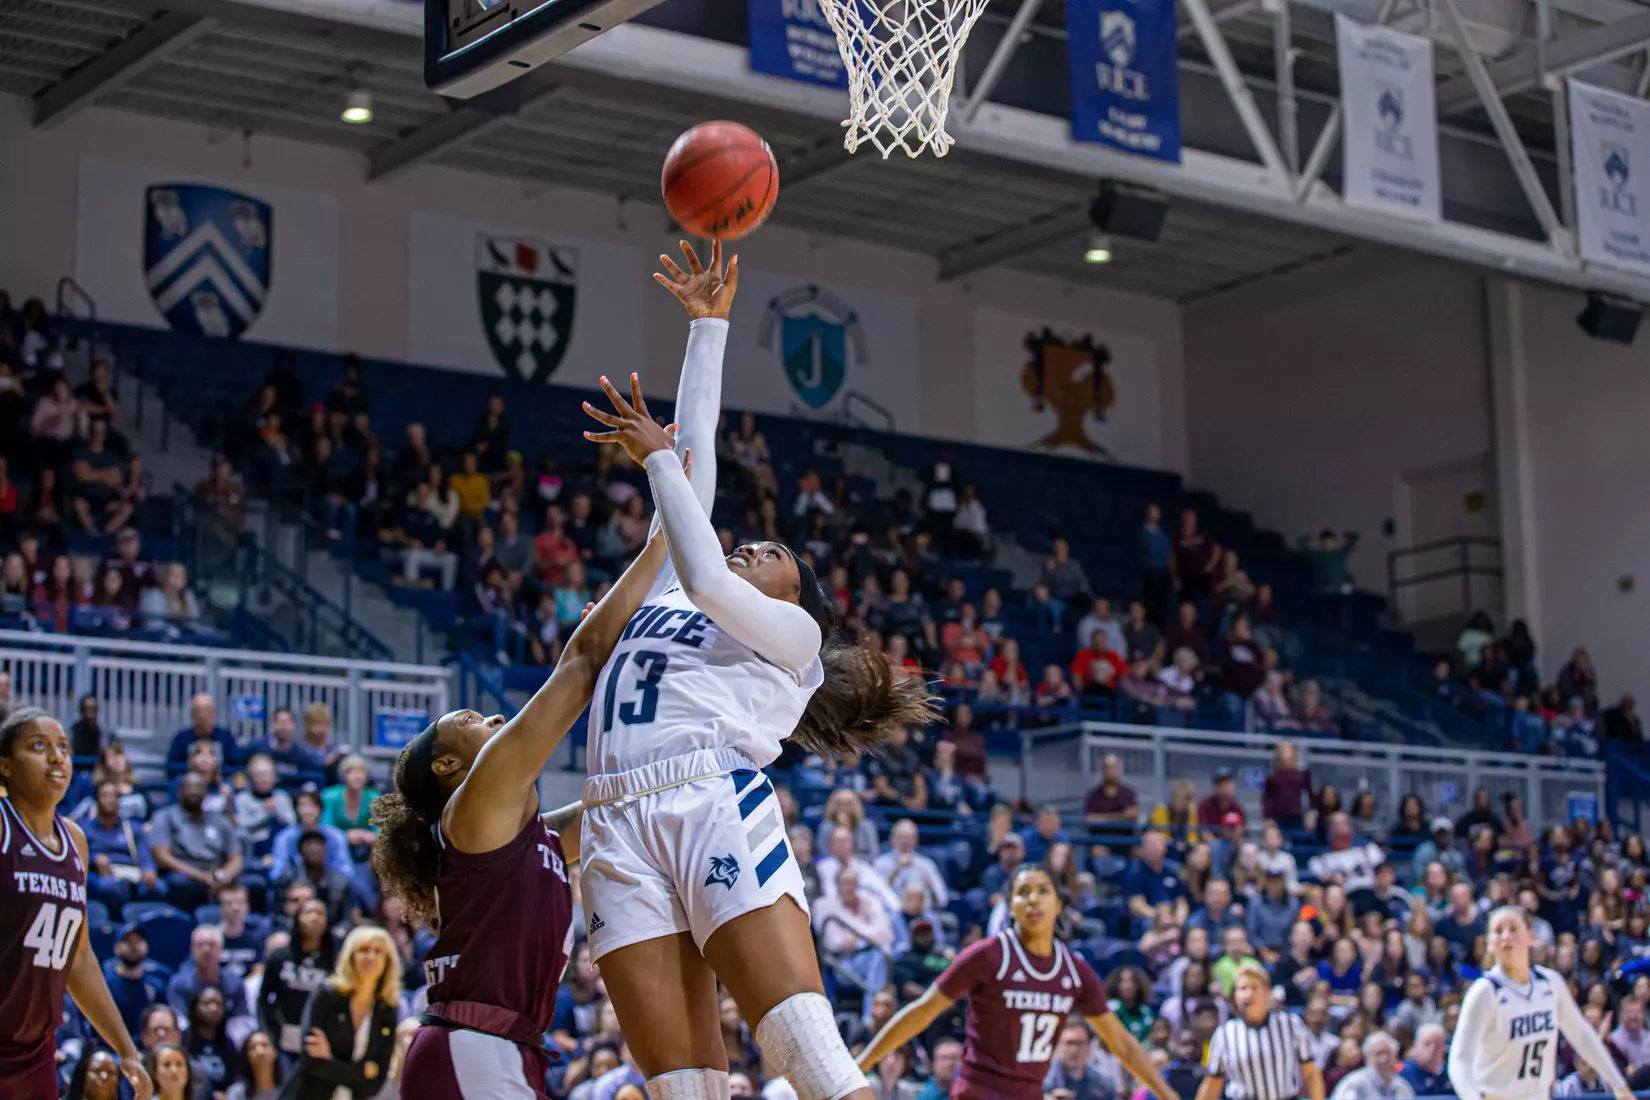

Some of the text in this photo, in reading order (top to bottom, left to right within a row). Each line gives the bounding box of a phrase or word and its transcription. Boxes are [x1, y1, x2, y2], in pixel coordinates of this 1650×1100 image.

[796, 328, 822, 389] J
[620, 605, 714, 649] RICE
[603, 650, 669, 733] 13
[13, 871, 68, 900] TEXAS
[23, 901, 83, 971] 40
[1002, 989, 1052, 1012] TEXAS
[1016, 1012, 1060, 1063] 12
[1509, 1010, 1555, 1041] RICE
[1518, 1040, 1549, 1081] 15
